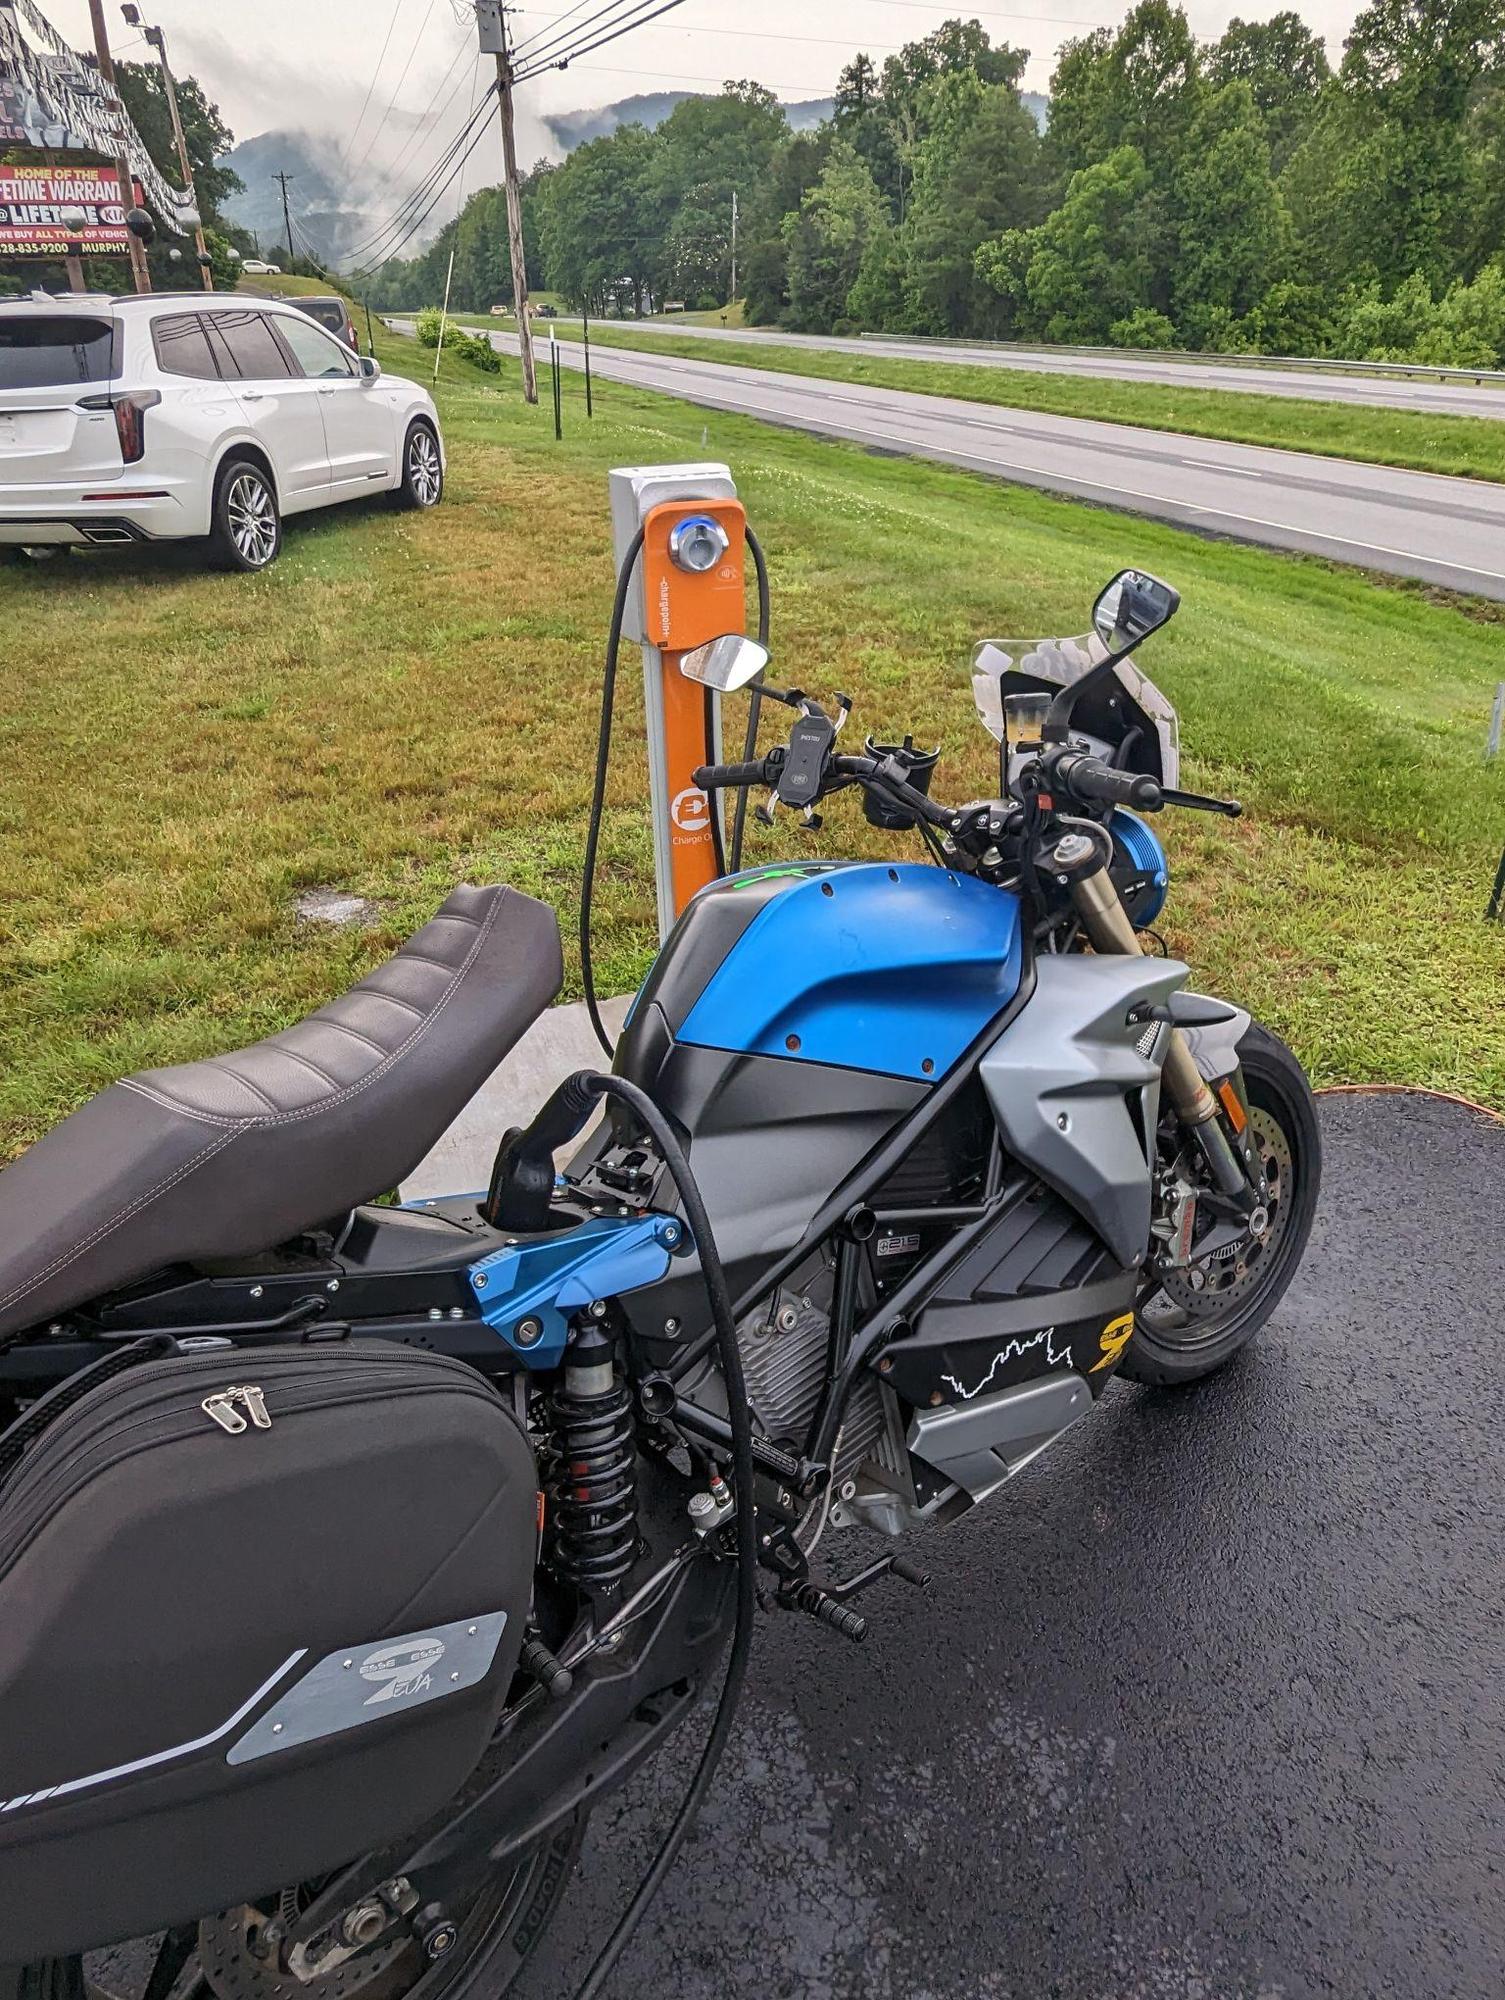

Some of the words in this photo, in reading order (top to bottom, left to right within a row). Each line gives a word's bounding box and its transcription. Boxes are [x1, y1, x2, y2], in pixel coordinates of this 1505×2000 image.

[14, 168, 52, 180] HOME
[55, 169, 72, 180] OF
[74, 170, 99, 181] THE
[48, 180, 122, 202] WARRANT
[9, 205, 99, 223] LIFETE
[14, 230, 33, 239] BUY
[36, 230, 53, 239] ALL
[55, 231, 83, 239] TYPES
[85, 231, 97, 239] OF
[0, 242, 69, 254] 28-835-9200
[672, 834, 703, 845] Charge
